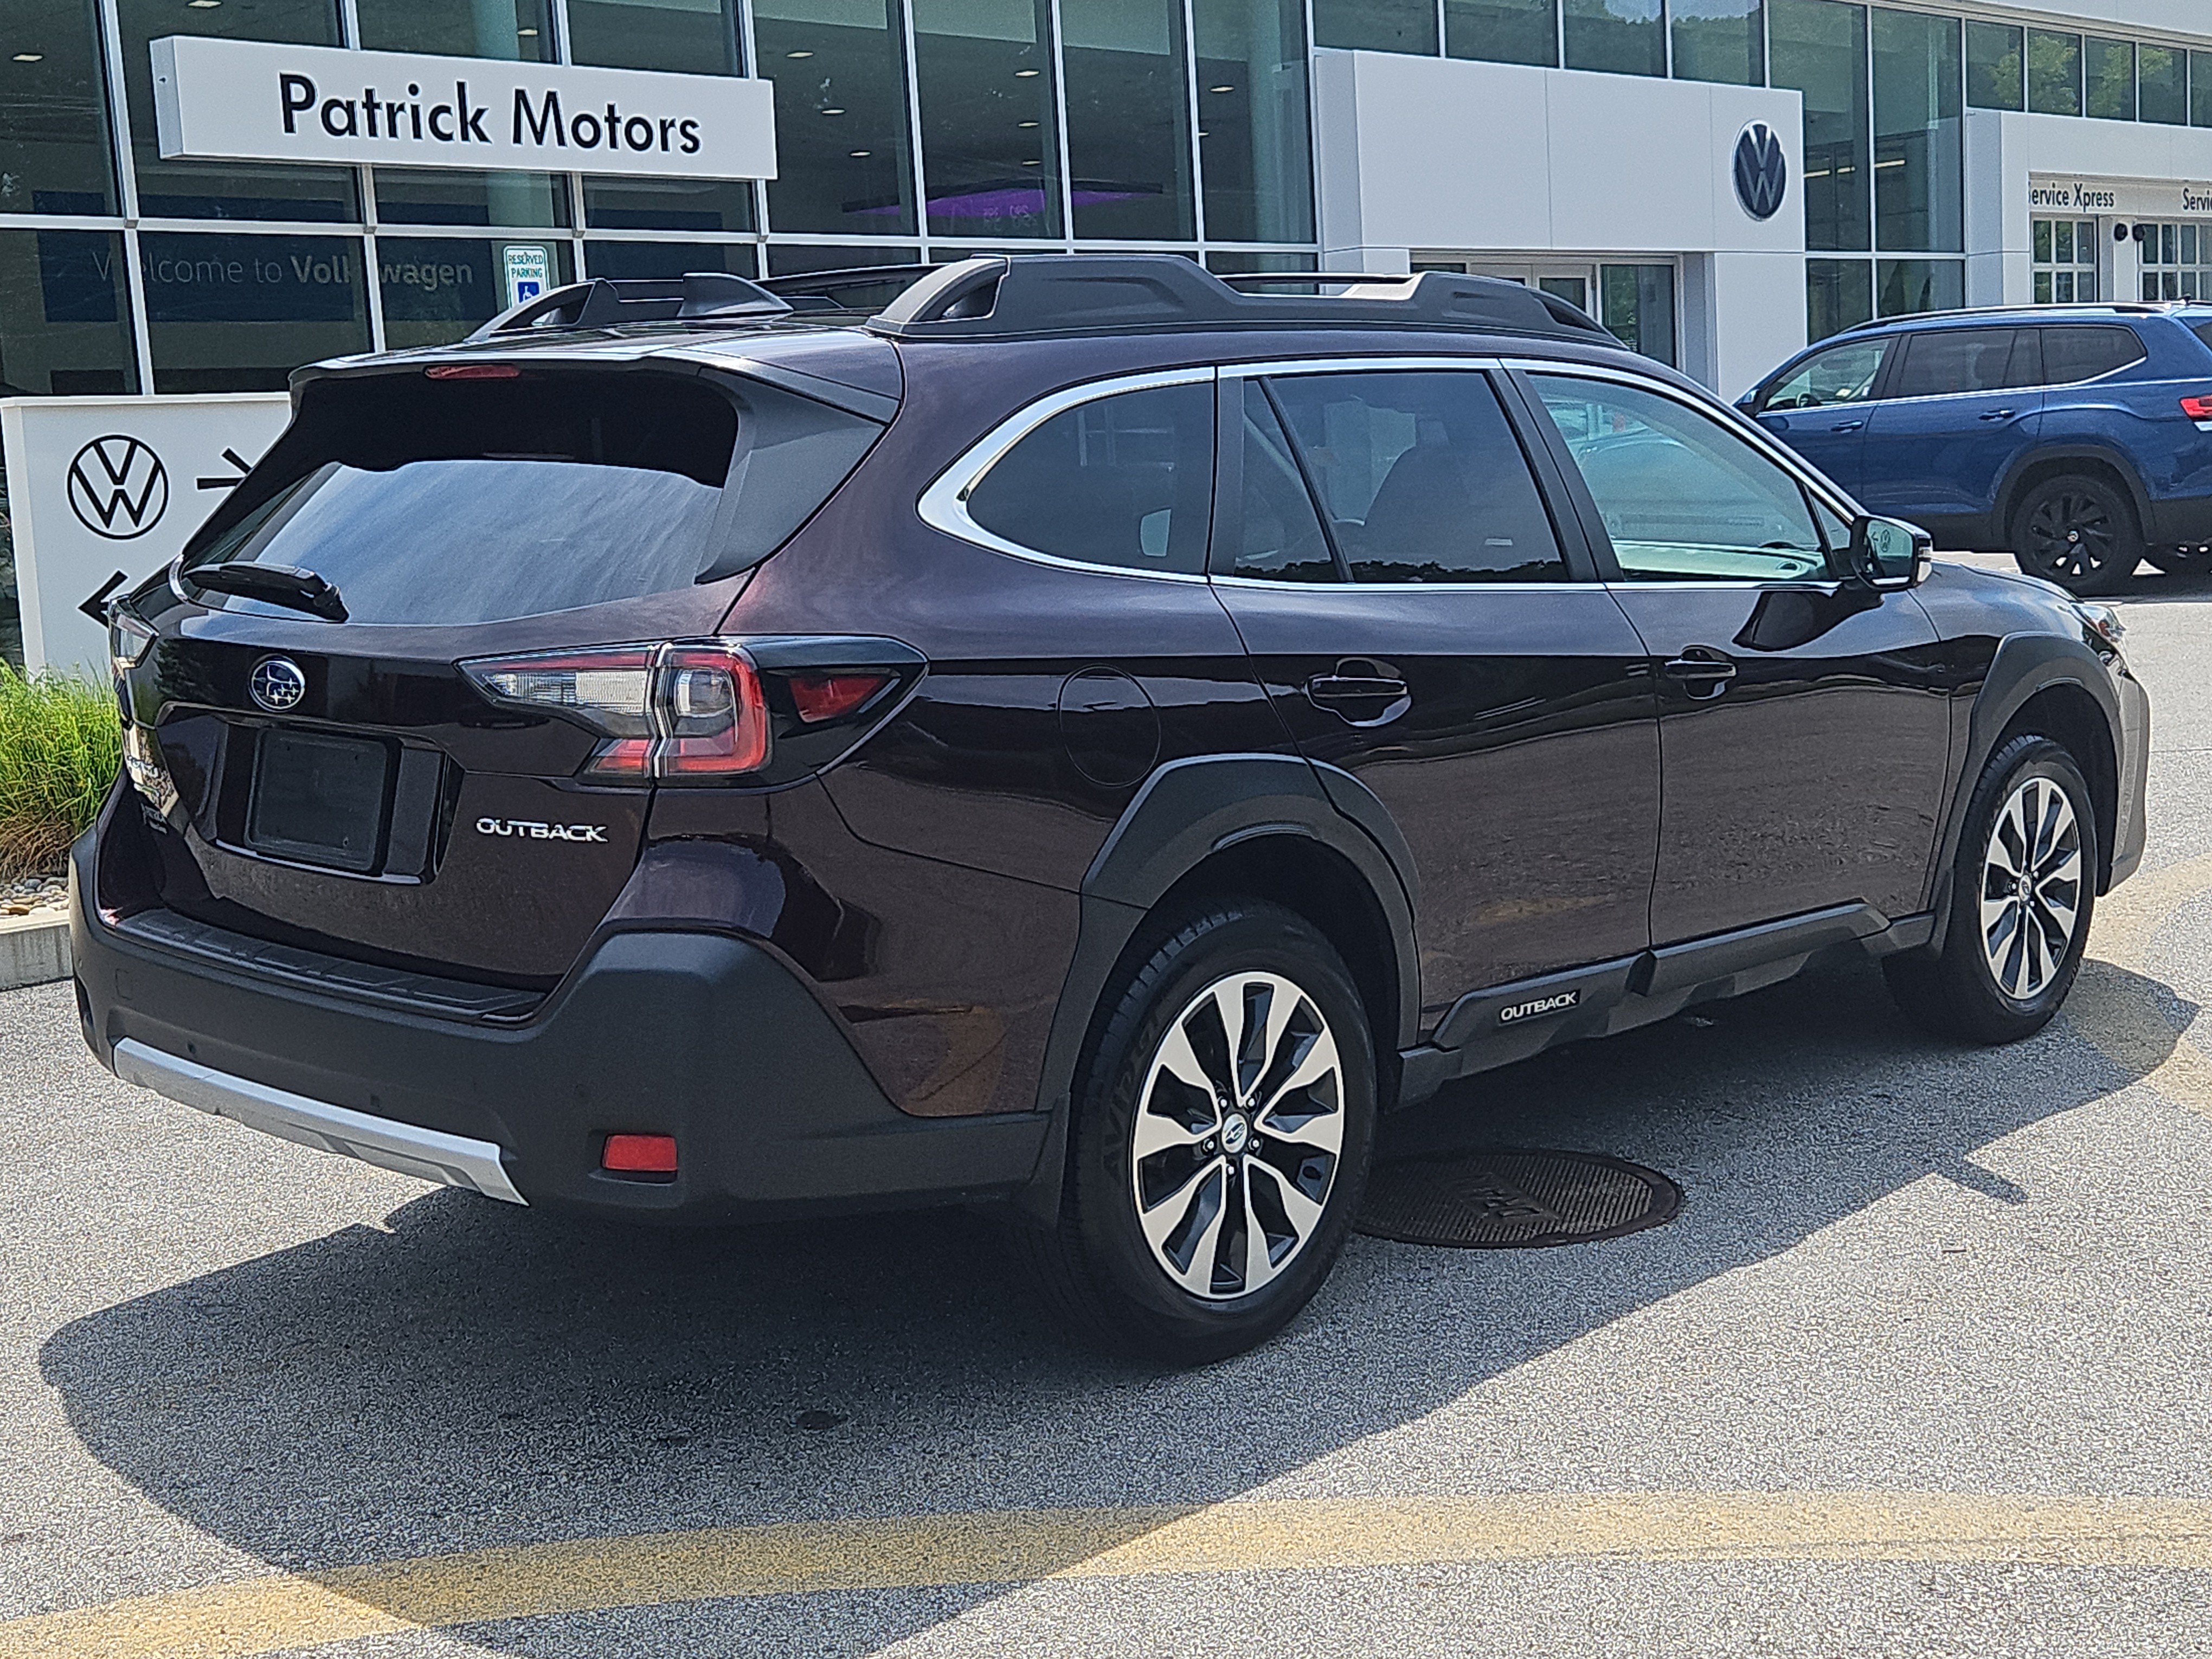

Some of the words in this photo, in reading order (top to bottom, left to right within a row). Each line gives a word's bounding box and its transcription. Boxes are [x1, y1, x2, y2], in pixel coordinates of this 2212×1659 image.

[279, 72, 492, 144] Patrick
[513, 88, 701, 153] Motors
[2029, 182, 2069, 206] ervice
[2073, 183, 2114, 213] Xpress
[92, 252, 243, 282] Wlcome
[254, 258, 282, 283] to
[290, 255, 473, 291] Volwagen
[508, 254, 543, 265] RESERVED
[511, 267, 543, 278] PARKING
[476, 818, 608, 842] OUTBACK
[1501, 992, 1576, 1020] OUTBACK
